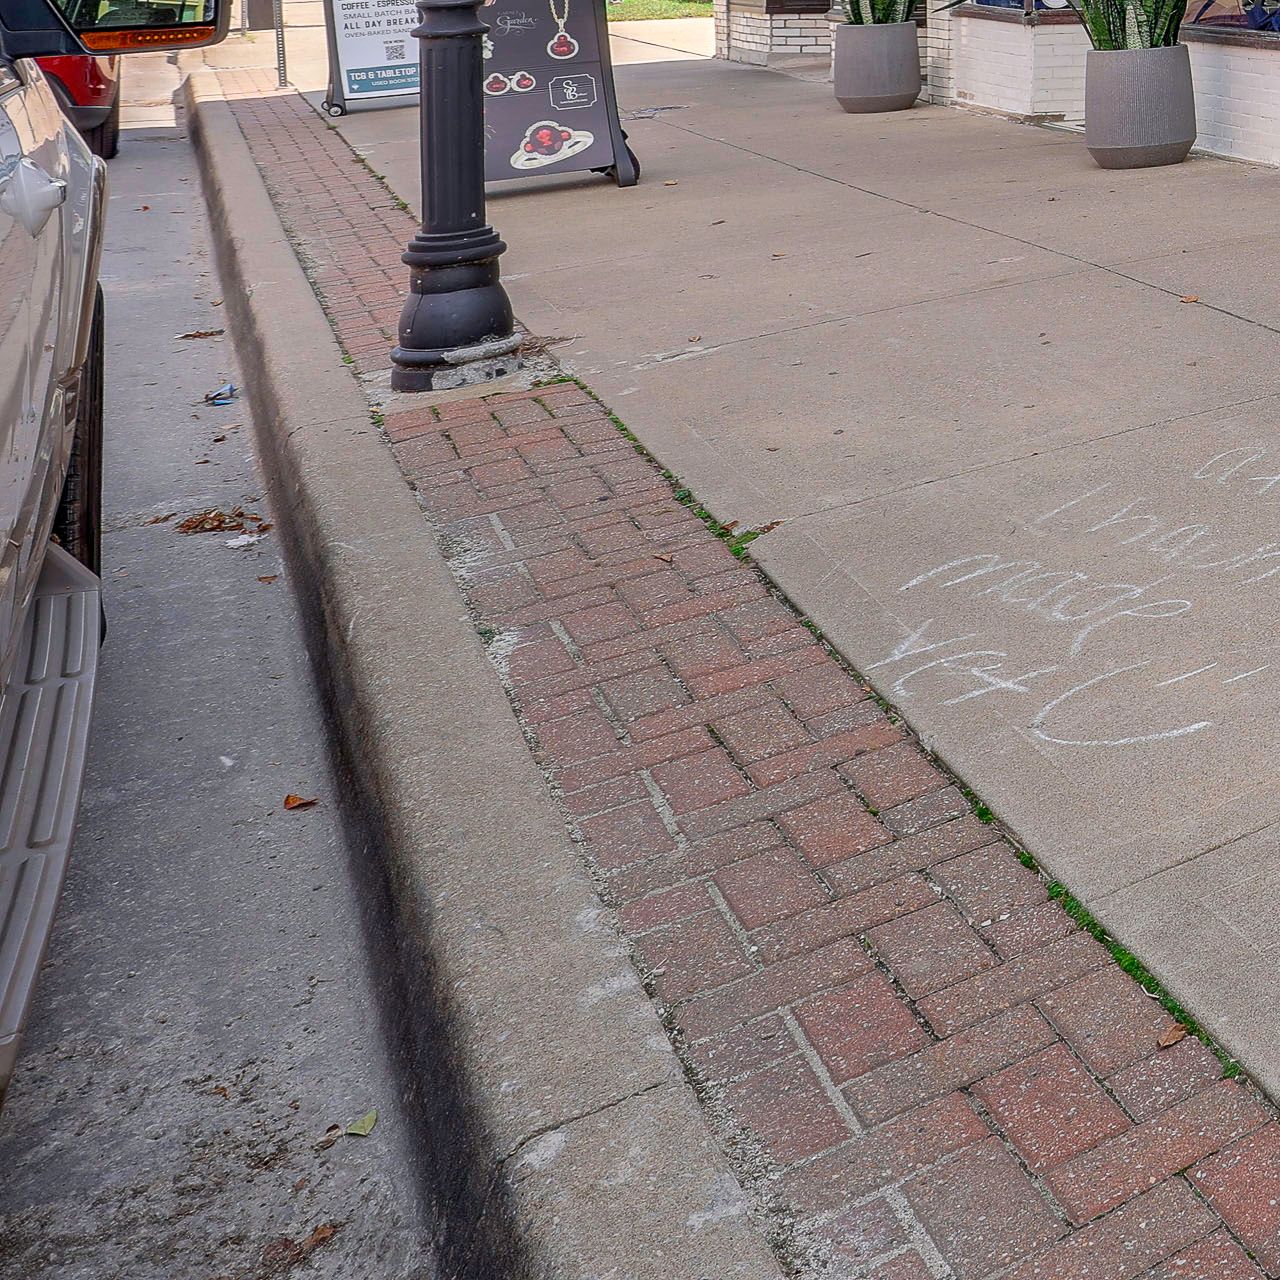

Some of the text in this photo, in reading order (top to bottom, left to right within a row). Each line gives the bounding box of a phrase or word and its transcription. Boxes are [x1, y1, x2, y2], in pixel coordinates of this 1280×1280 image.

[341, 0, 370, 11] COFFEE
[343, 12, 373, 20] SMALL
[374, 9, 403, 18] BATCH
[343, 17, 420, 30] ALL DAY BREAK
[349, 72, 366, 81] TCG
[376, 67, 417, 79] TABLETOP
